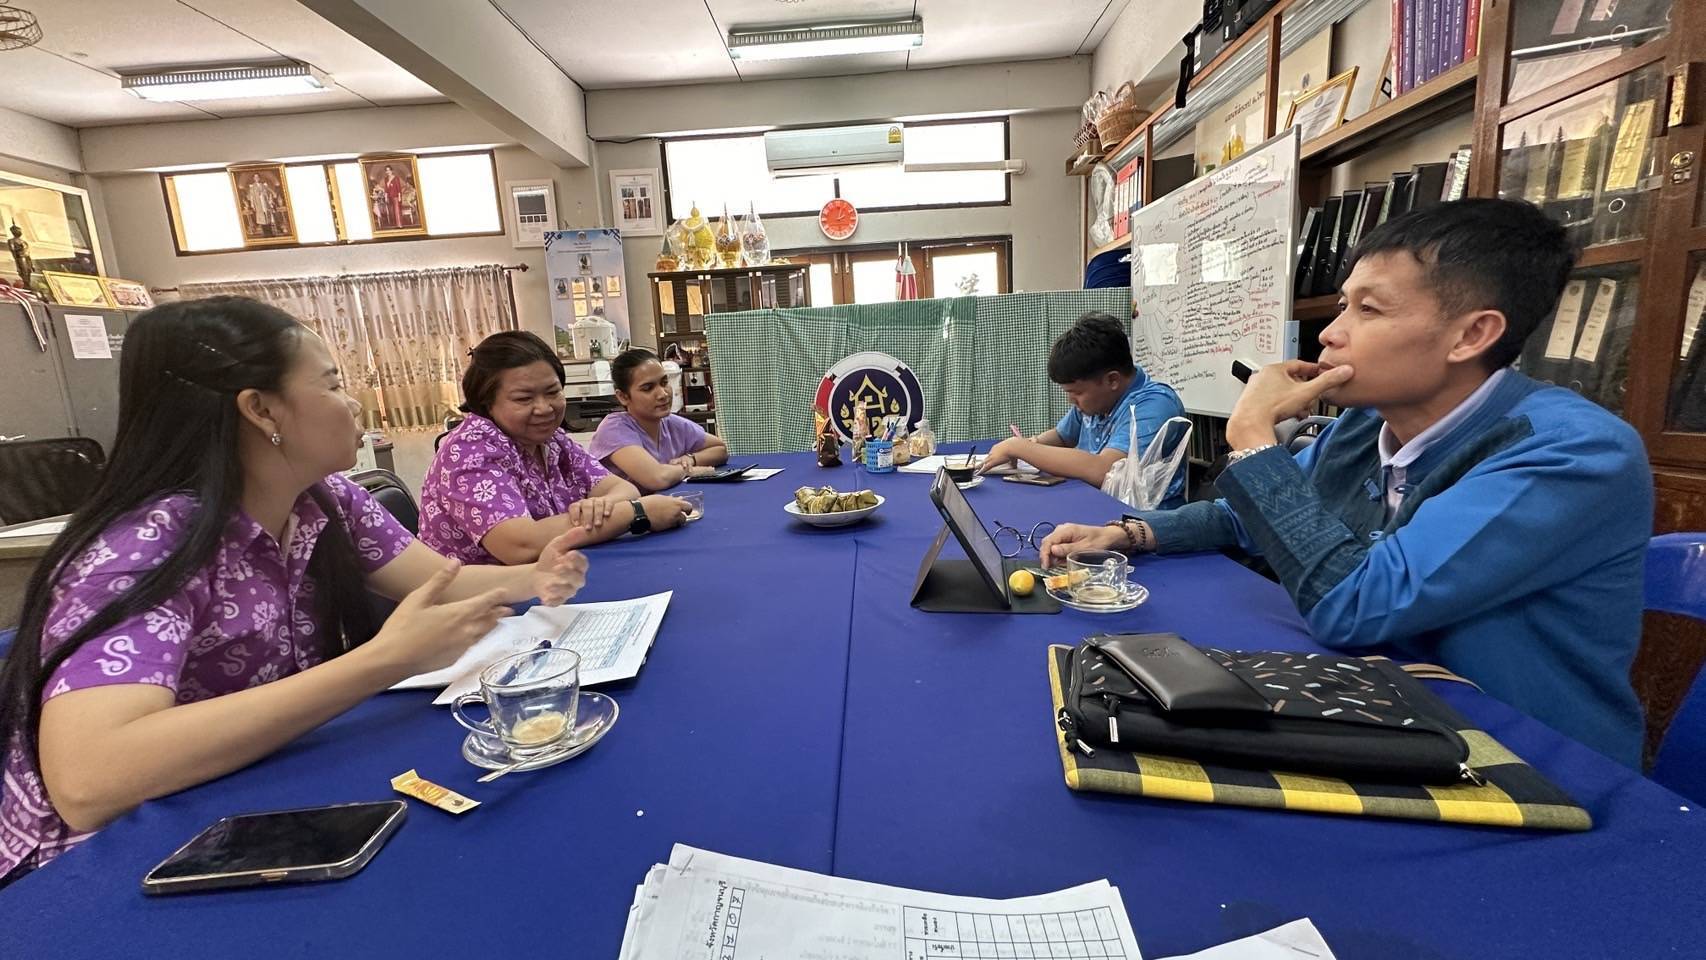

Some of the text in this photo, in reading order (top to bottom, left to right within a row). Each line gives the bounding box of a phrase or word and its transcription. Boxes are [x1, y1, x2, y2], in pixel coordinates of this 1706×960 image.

[706, 880, 728, 948] จังหวัดกาญจนบุรี
